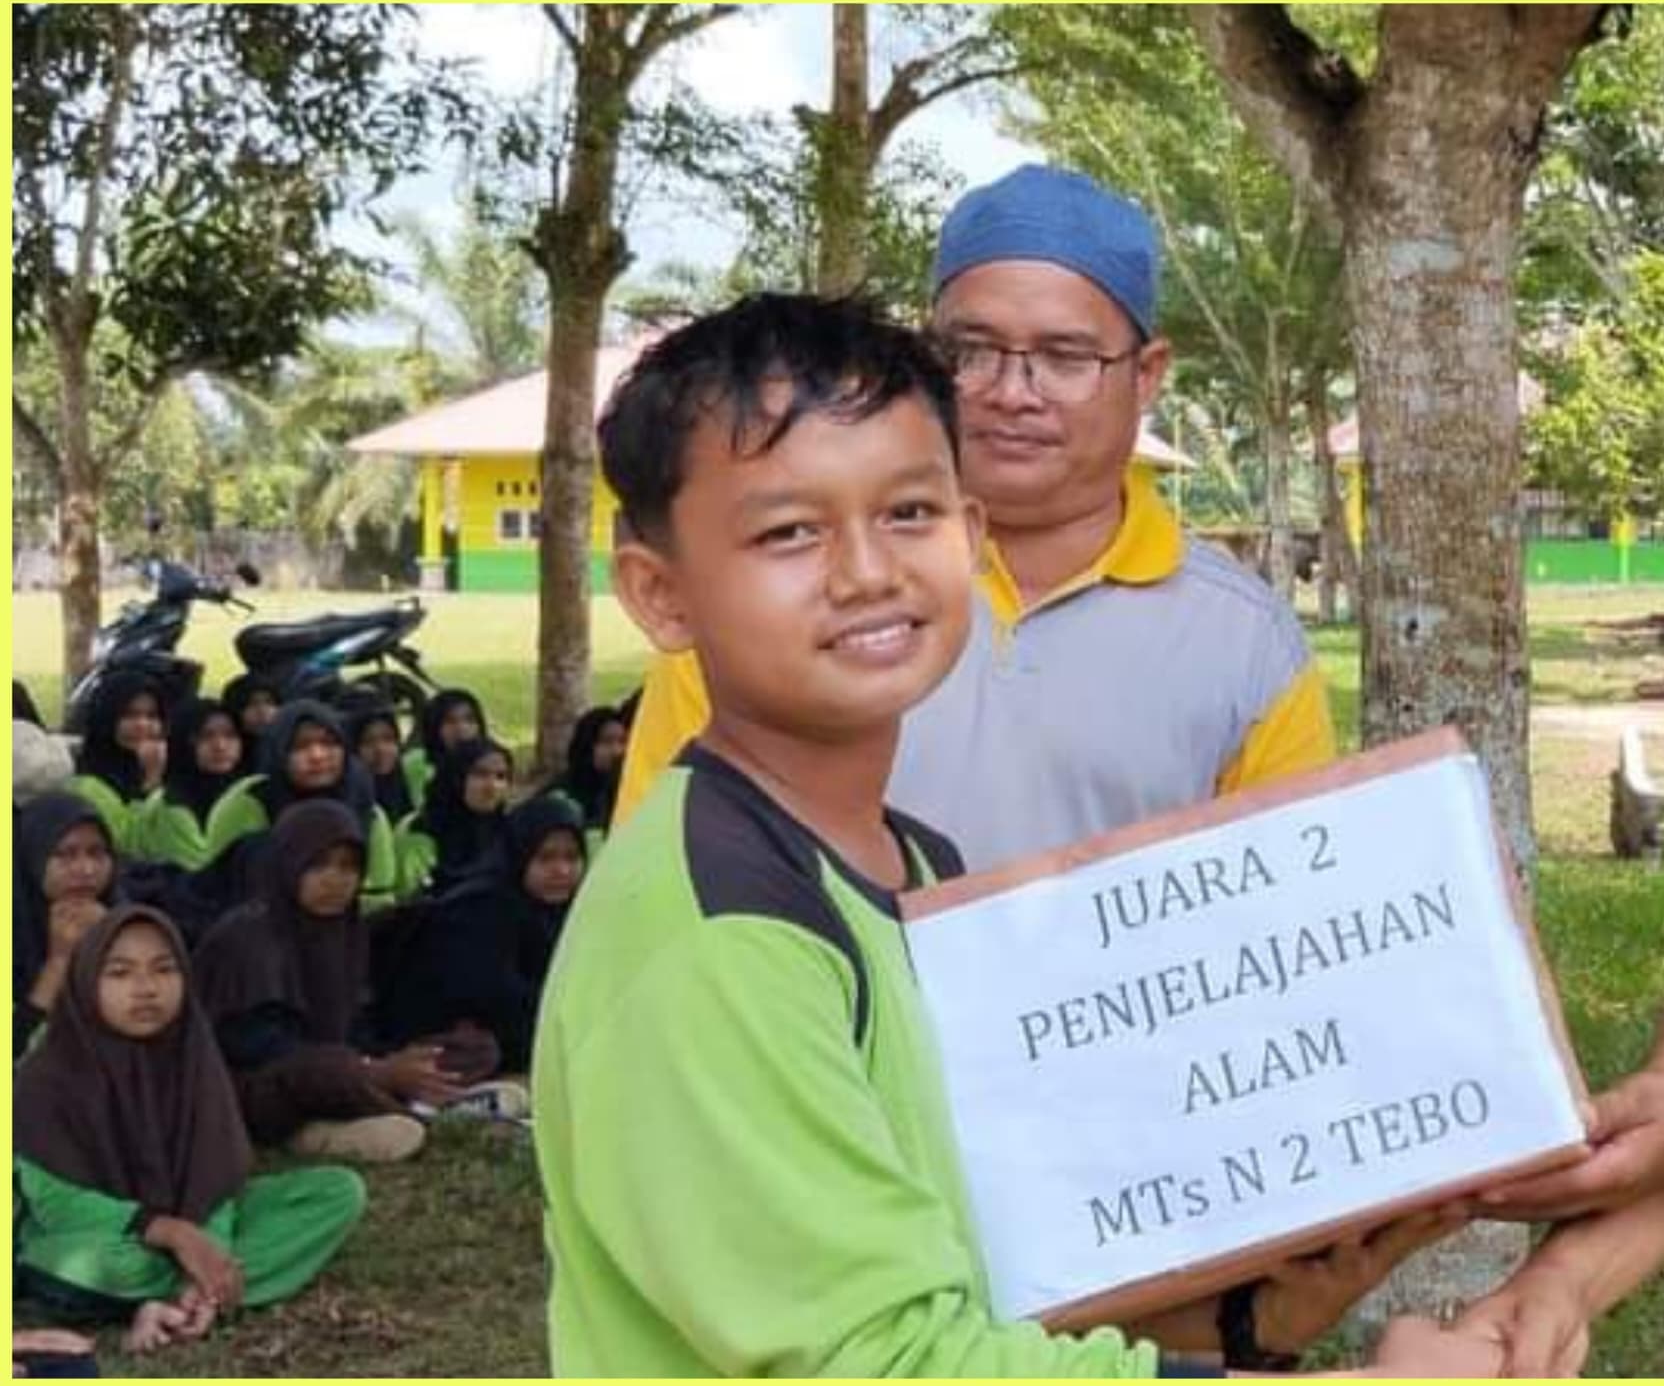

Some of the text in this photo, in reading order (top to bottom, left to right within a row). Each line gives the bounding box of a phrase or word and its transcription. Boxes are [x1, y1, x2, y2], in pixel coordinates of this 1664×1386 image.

[1090, 823, 1339, 950] JUARA 2
[1016, 882, 1457, 1063] PENJELAJAHAN
[1182, 1017, 1349, 1116] ALAM
[1086, 1078, 1491, 1248] MTs N 2 TEBO
